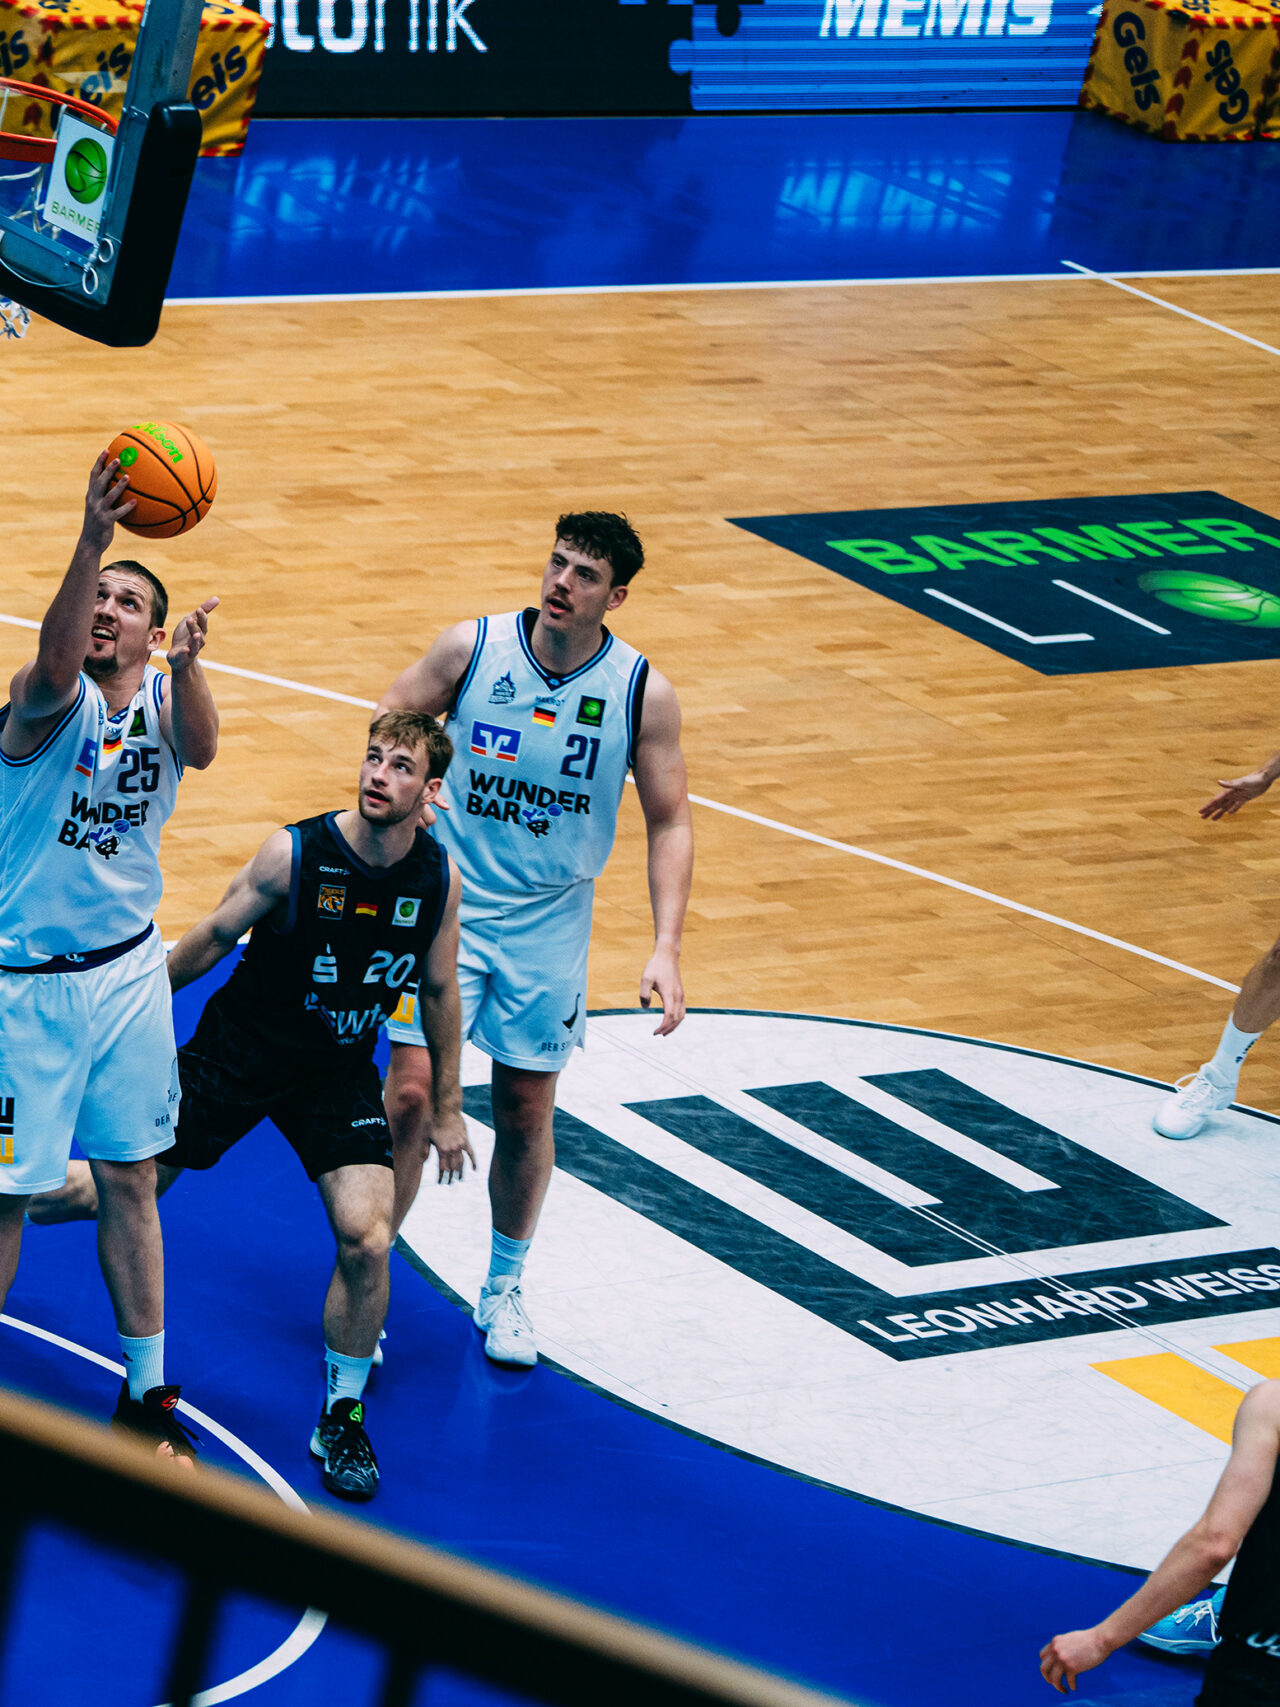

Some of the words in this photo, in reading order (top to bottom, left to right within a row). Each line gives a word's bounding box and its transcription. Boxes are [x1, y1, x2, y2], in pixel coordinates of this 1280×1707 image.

[191, 45, 248, 110] eis
[825, 517, 1280, 575] BARMER
[117, 747, 161, 794] 25
[560, 733, 601, 781] 21
[70, 791, 150, 827] WNDER
[466, 791, 521, 827] BAR
[469, 768, 591, 815] WUNDER
[57, 818, 91, 852] BA
[362, 949, 416, 989] 20
[351, 1118, 379, 1128] CRAFT
[857, 1284, 1150, 1343] LEONHARD
[1134, 1263, 1280, 1303] WEISS
